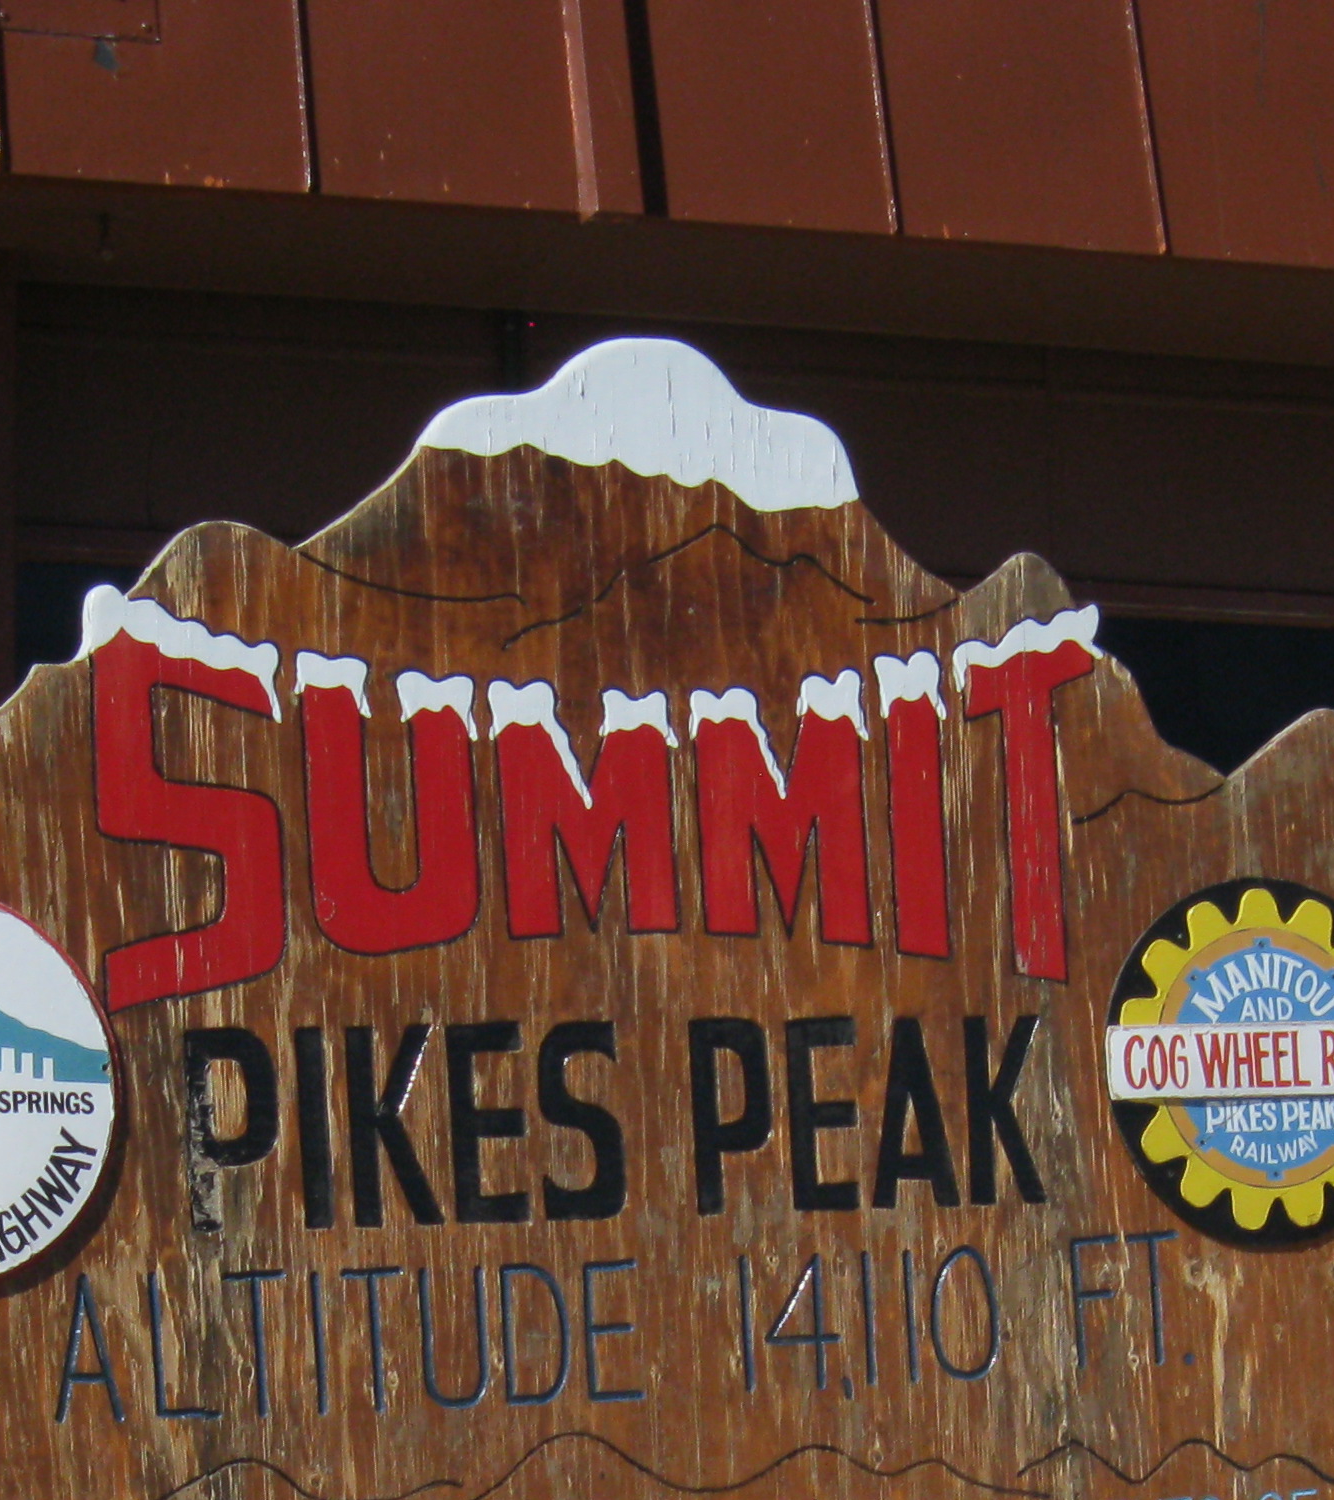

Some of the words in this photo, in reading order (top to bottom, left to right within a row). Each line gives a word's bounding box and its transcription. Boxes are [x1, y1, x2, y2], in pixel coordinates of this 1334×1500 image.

[79, 586, 1101, 1014] SUMMIT
[1239, 996, 1294, 1022] AND
[1123, 1033, 1190, 1090] COG
[1195, 1030, 1312, 1089] WHEEL
[185, 1019, 628, 1232] PIKES
[687, 1014, 1047, 1216] PEAK
[1205, 1099, 1277, 1134] PIKES
[1229, 1131, 1319, 1165] RAILWAY
[56, 1258, 646, 1420] ALTITUDE
[1069, 1231, 1193, 1370] FT.
